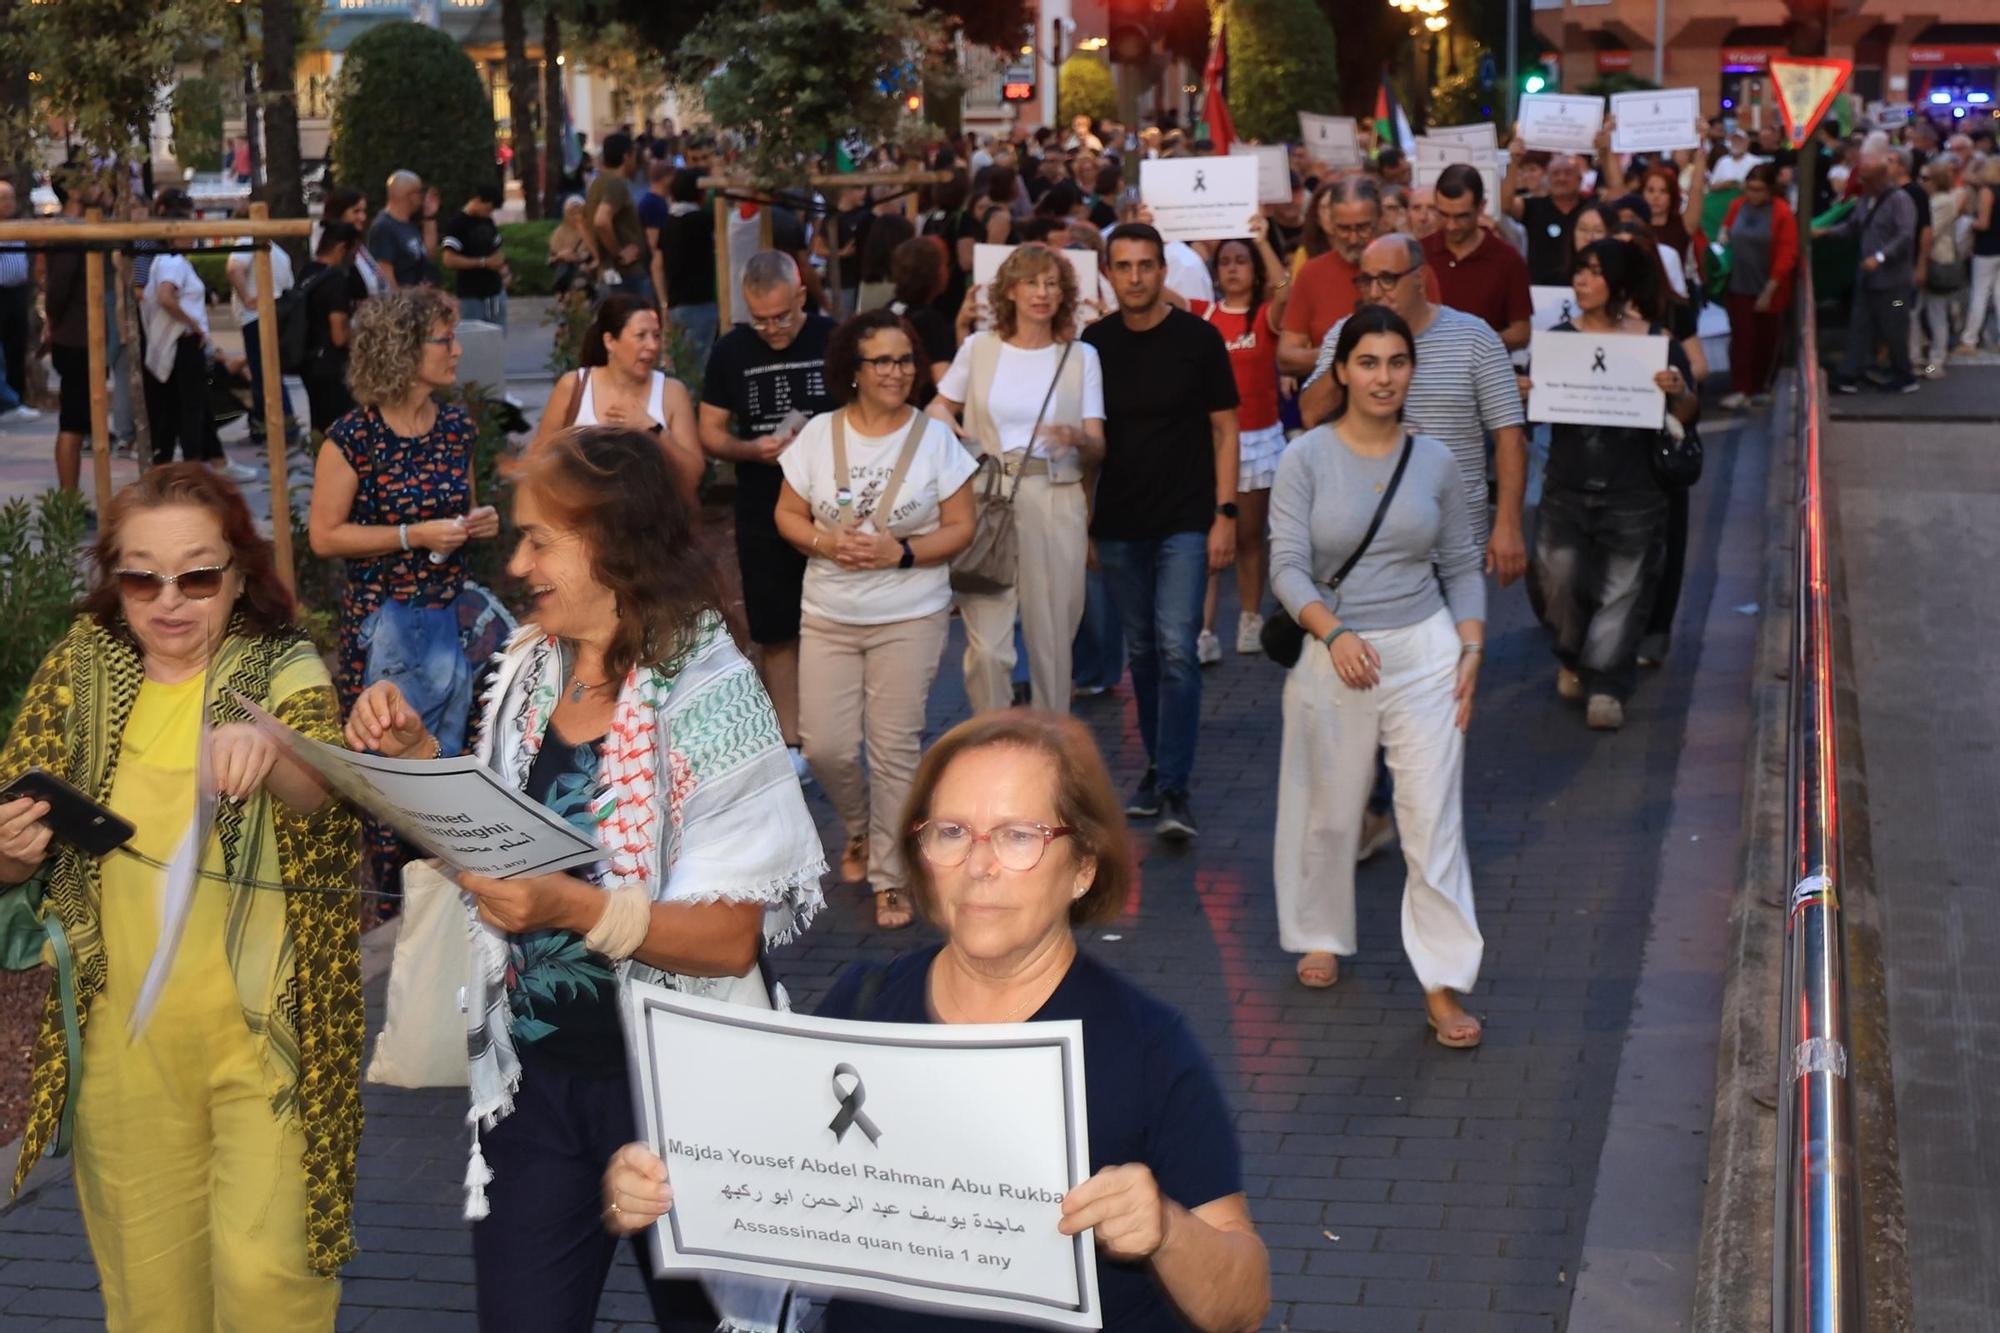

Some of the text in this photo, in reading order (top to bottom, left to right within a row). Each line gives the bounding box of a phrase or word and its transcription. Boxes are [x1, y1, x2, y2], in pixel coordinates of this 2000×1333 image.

[667, 1138, 723, 1162] Majda
[727, 1147, 795, 1169] Yousef
[800, 1157, 858, 1177] Abdel
[863, 1164, 945, 1189] Rahman
[951, 1176, 993, 1196] Abu
[800, 1193, 865, 1213] الرحمن
[871, 1201, 901, 1219] عبد
[908, 1204, 967, 1230] يوسف
[972, 1212, 1028, 1235] ماجدة
[732, 1216, 1012, 1271] Assassinada quan tenia 1 any
